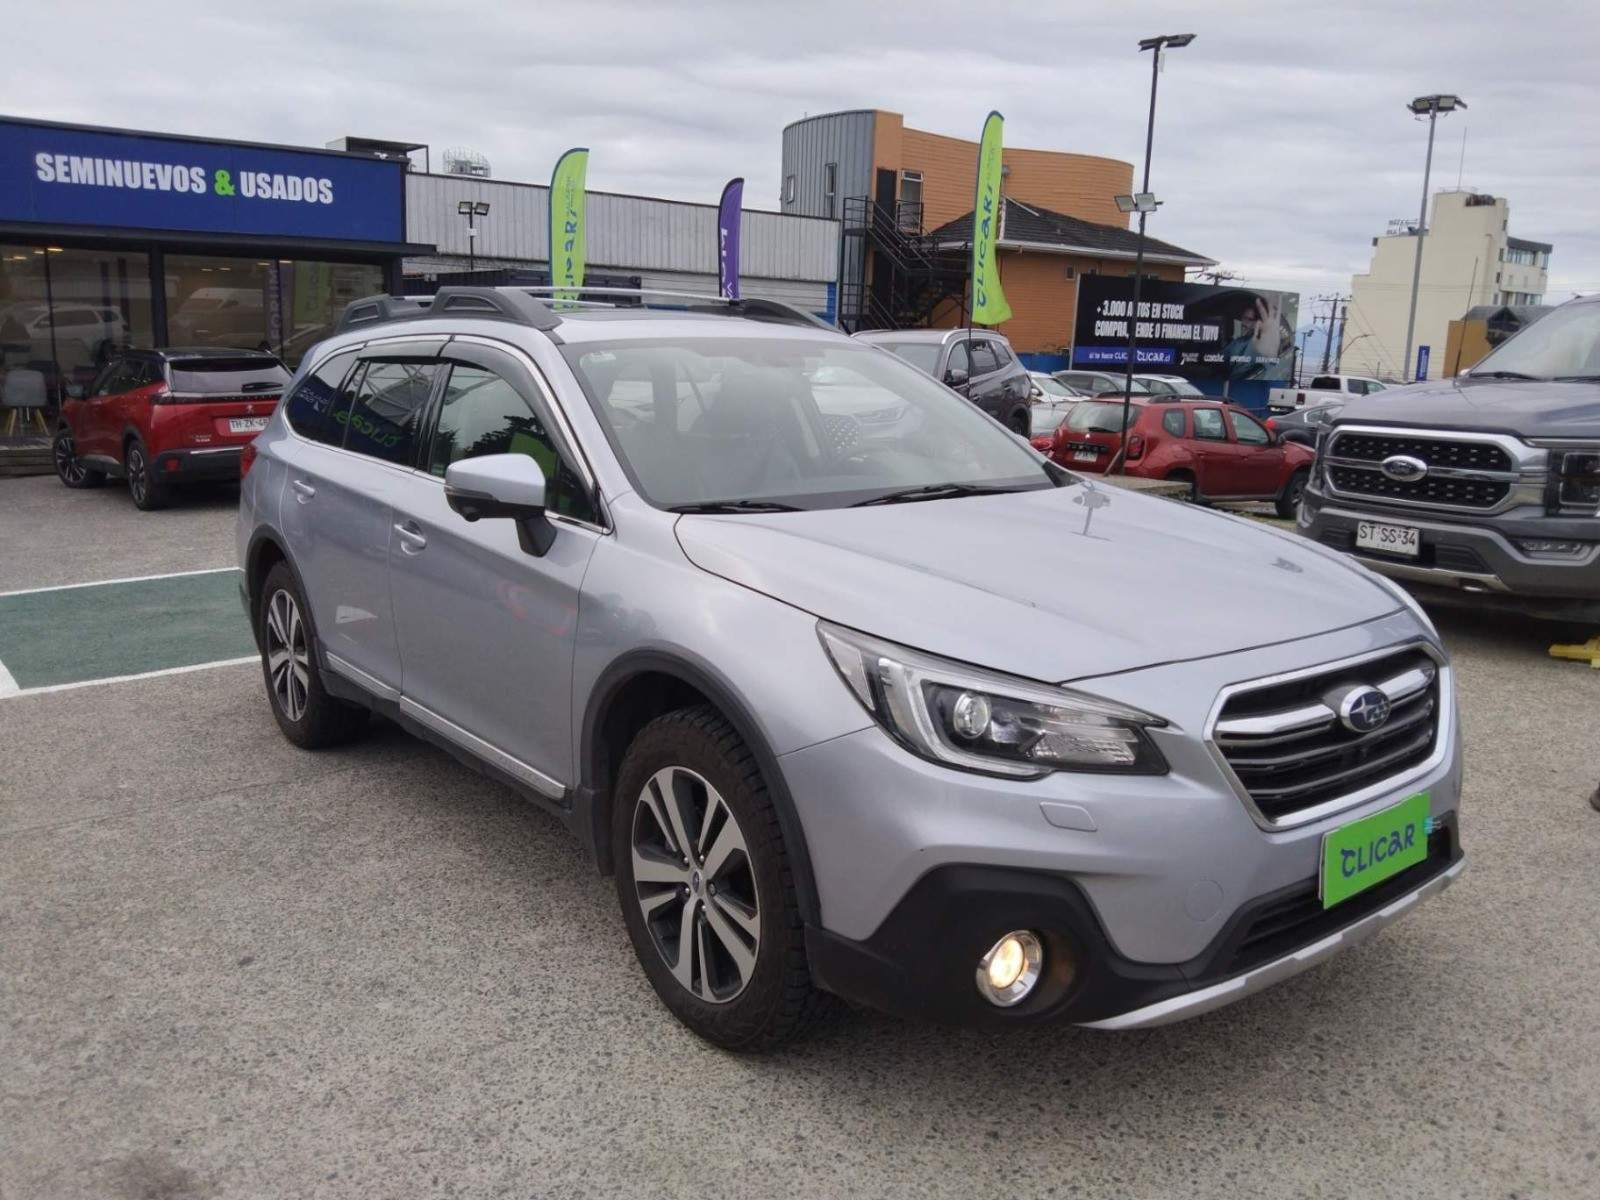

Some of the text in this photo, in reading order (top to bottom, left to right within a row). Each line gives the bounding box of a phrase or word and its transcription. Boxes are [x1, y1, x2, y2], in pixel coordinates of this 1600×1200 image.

[35, 152, 333, 204] SEMINUEVOS & USADOS
[1127, 301, 1150, 318] ATOS
[1162, 303, 1184, 320] STOCK
[1134, 322, 1154, 338] ENDE
[1161, 323, 1192, 340] FINANCIA
[1202, 325, 1219, 341] TUYO
